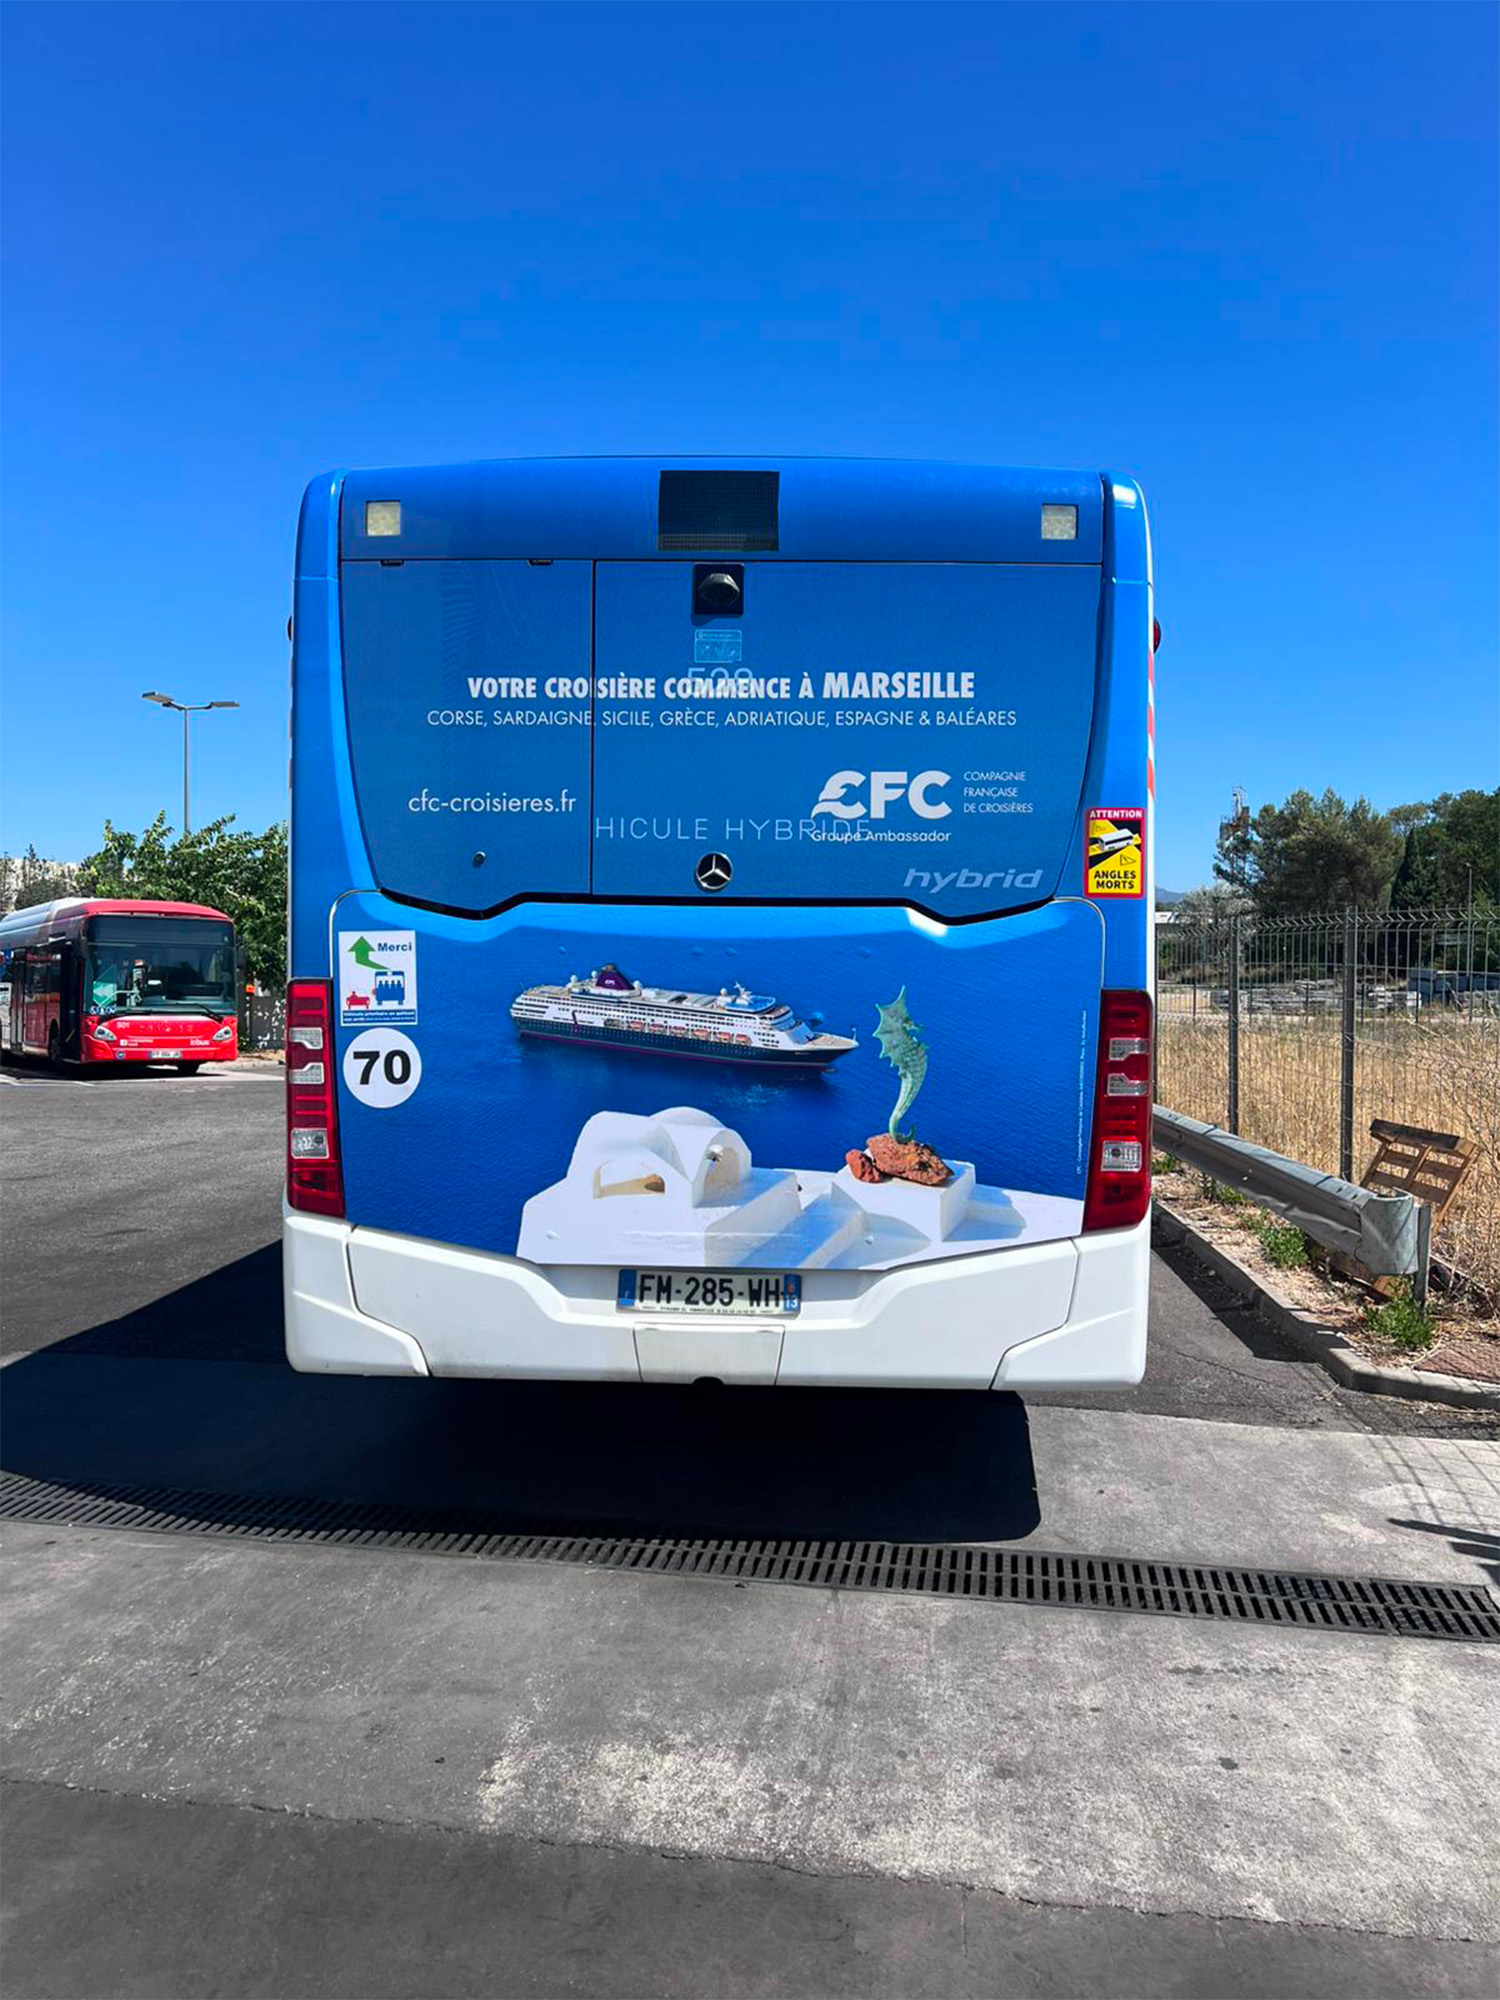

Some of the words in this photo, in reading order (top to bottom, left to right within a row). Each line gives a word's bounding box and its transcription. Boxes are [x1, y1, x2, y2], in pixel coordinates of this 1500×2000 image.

[467, 677, 537, 699] VOTRE
[663, 677, 791, 699] COMMENCE
[798, 671, 814, 699] À
[822, 671, 975, 699] MARSEILLE
[427, 710, 488, 728] CORSE,
[602, 710, 654, 728] SICILE,
[660, 706, 719, 728] GRÈCE,
[725, 710, 830, 728] ADRIATIQUE,
[835, 710, 913, 727] ESPAGNE
[919, 710, 931, 727] &
[936, 706, 1017, 727] BALÉARES
[963, 770, 1026, 782] COMPAGNIE
[408, 788, 577, 812] cfc-croisieres.fr
[810, 769, 952, 820] CFC
[963, 787, 1019, 799] FRANÇAISE
[963, 803, 977, 814] DE
[978, 801, 1034, 814] CROISIÈRES
[1090, 809, 1142, 819] ATTENTION
[811, 830, 861, 844] Groupe
[867, 829, 952, 843] Ambassador
[903, 867, 1043, 894] hybrid
[1094, 870, 1137, 880] ANGLES
[1096, 880, 1135, 890] MORTS
[377, 942, 413, 953] Merci
[352, 1049, 412, 1086] 70
[638, 1274, 781, 1308] FM-285-WH
[785, 1294, 798, 1309] 13
